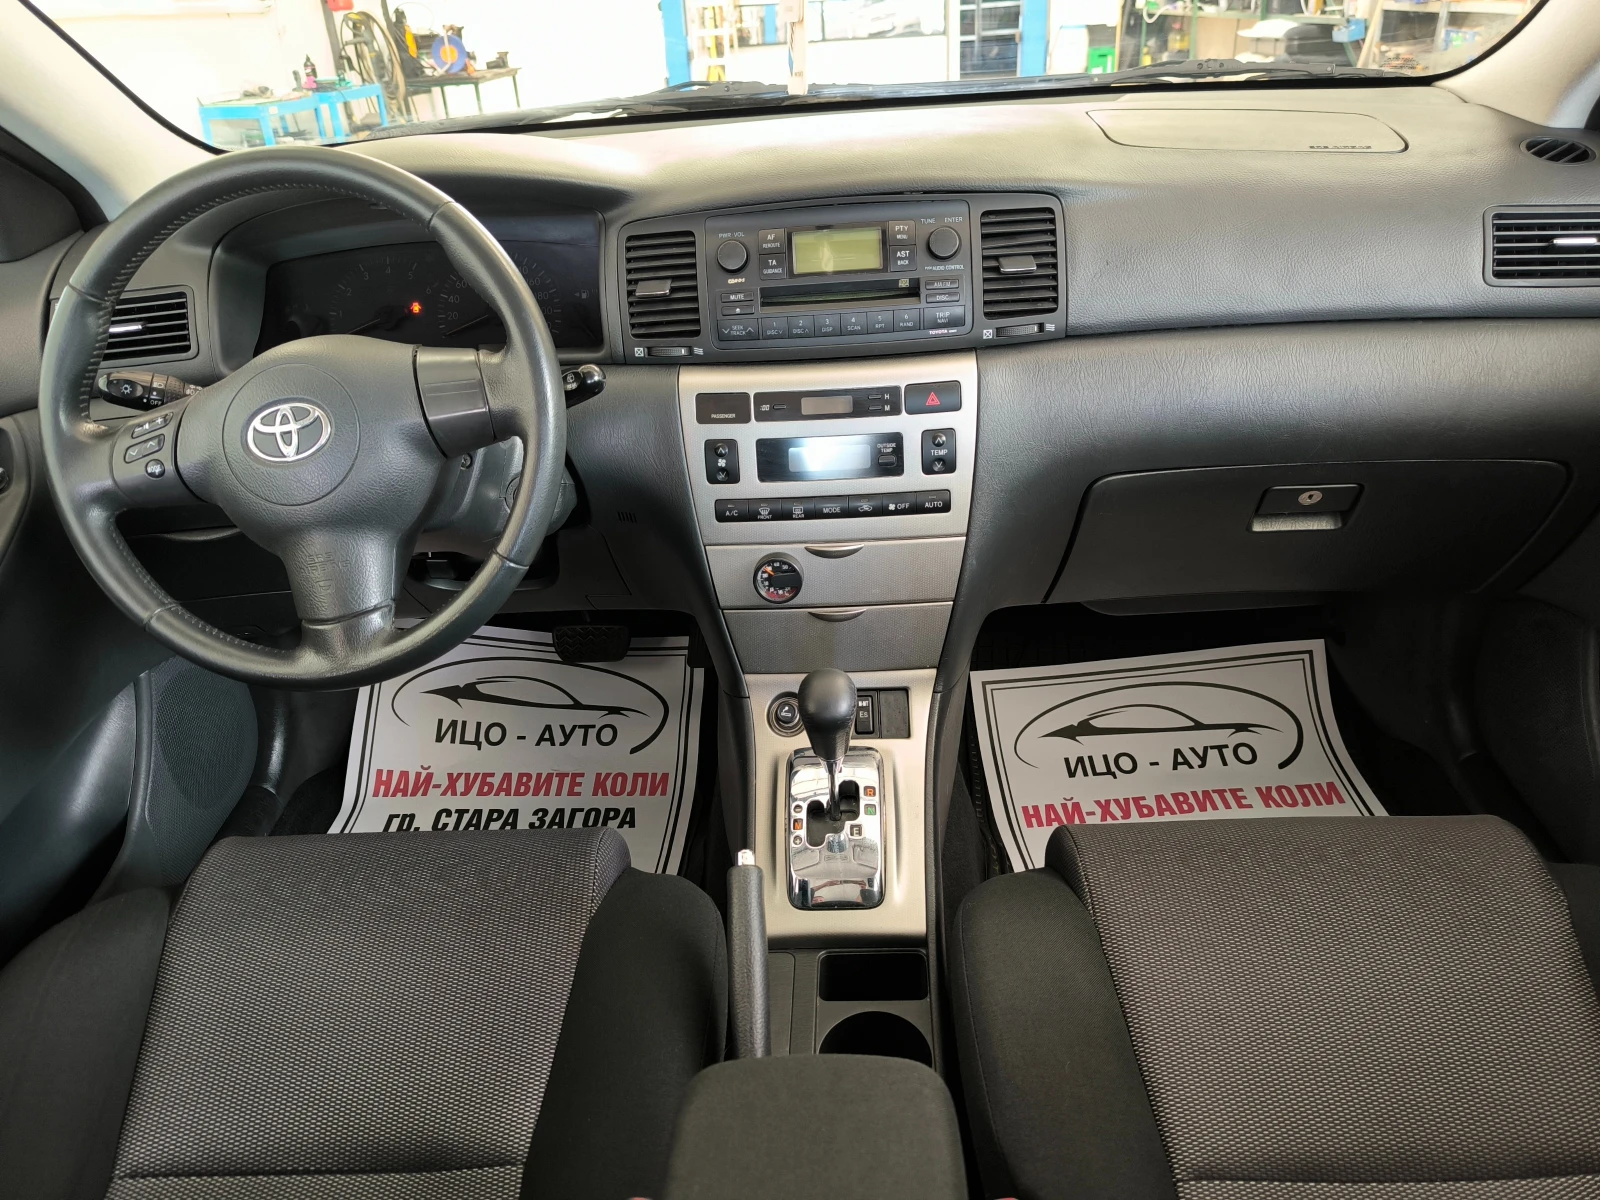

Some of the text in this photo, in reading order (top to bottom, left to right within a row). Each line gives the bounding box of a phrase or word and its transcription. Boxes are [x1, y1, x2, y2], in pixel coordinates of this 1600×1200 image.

[385, 266, 391, 274] 4
[364, 272, 369, 280] 3
[408, 272, 414, 280] 5
[456, 279, 468, 288] 60
[346, 287, 352, 296] 2
[426, 286, 432, 294] 6
[448, 295, 460, 304] 40
[447, 312, 458, 320] 20
[434, 718, 507, 750] ИЦО
[535, 723, 618, 747] АУТО
[1064, 752, 1138, 780] ИЦО
[1171, 742, 1258, 771] АУТО
[372, 764, 670, 798] НАЙ-ХУБАВИТЕ КОЛИ
[1021, 781, 1346, 829] НАЙ-ХУБАВИТЕ КОЛИ
[431, 808, 520, 832] СТАРА
[528, 807, 636, 830] ЗАГОРА
